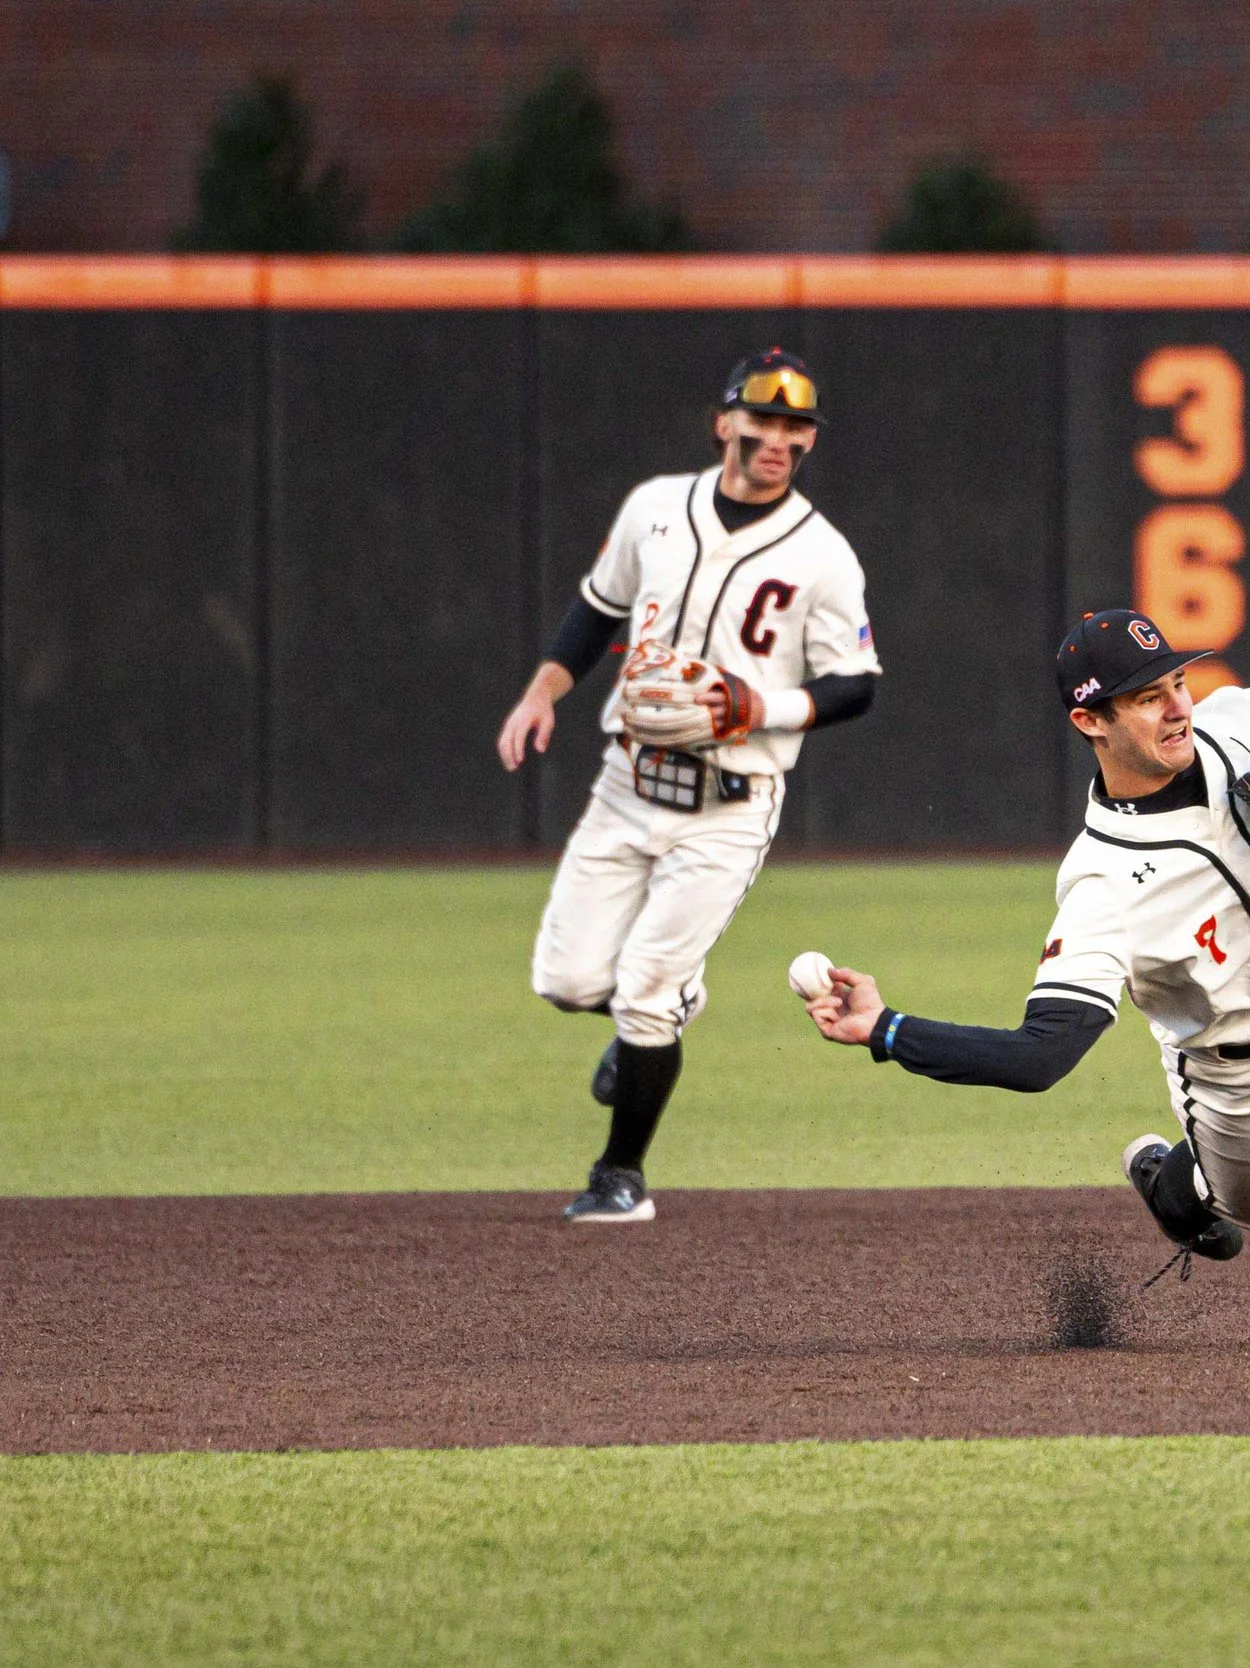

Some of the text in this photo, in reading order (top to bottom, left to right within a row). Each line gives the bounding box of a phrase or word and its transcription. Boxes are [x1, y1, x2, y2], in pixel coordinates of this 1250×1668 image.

[740, 578, 799, 656] C
[1128, 620, 1160, 650] C
[1073, 677, 1102, 702] CAA
[1193, 914, 1227, 966] 7
